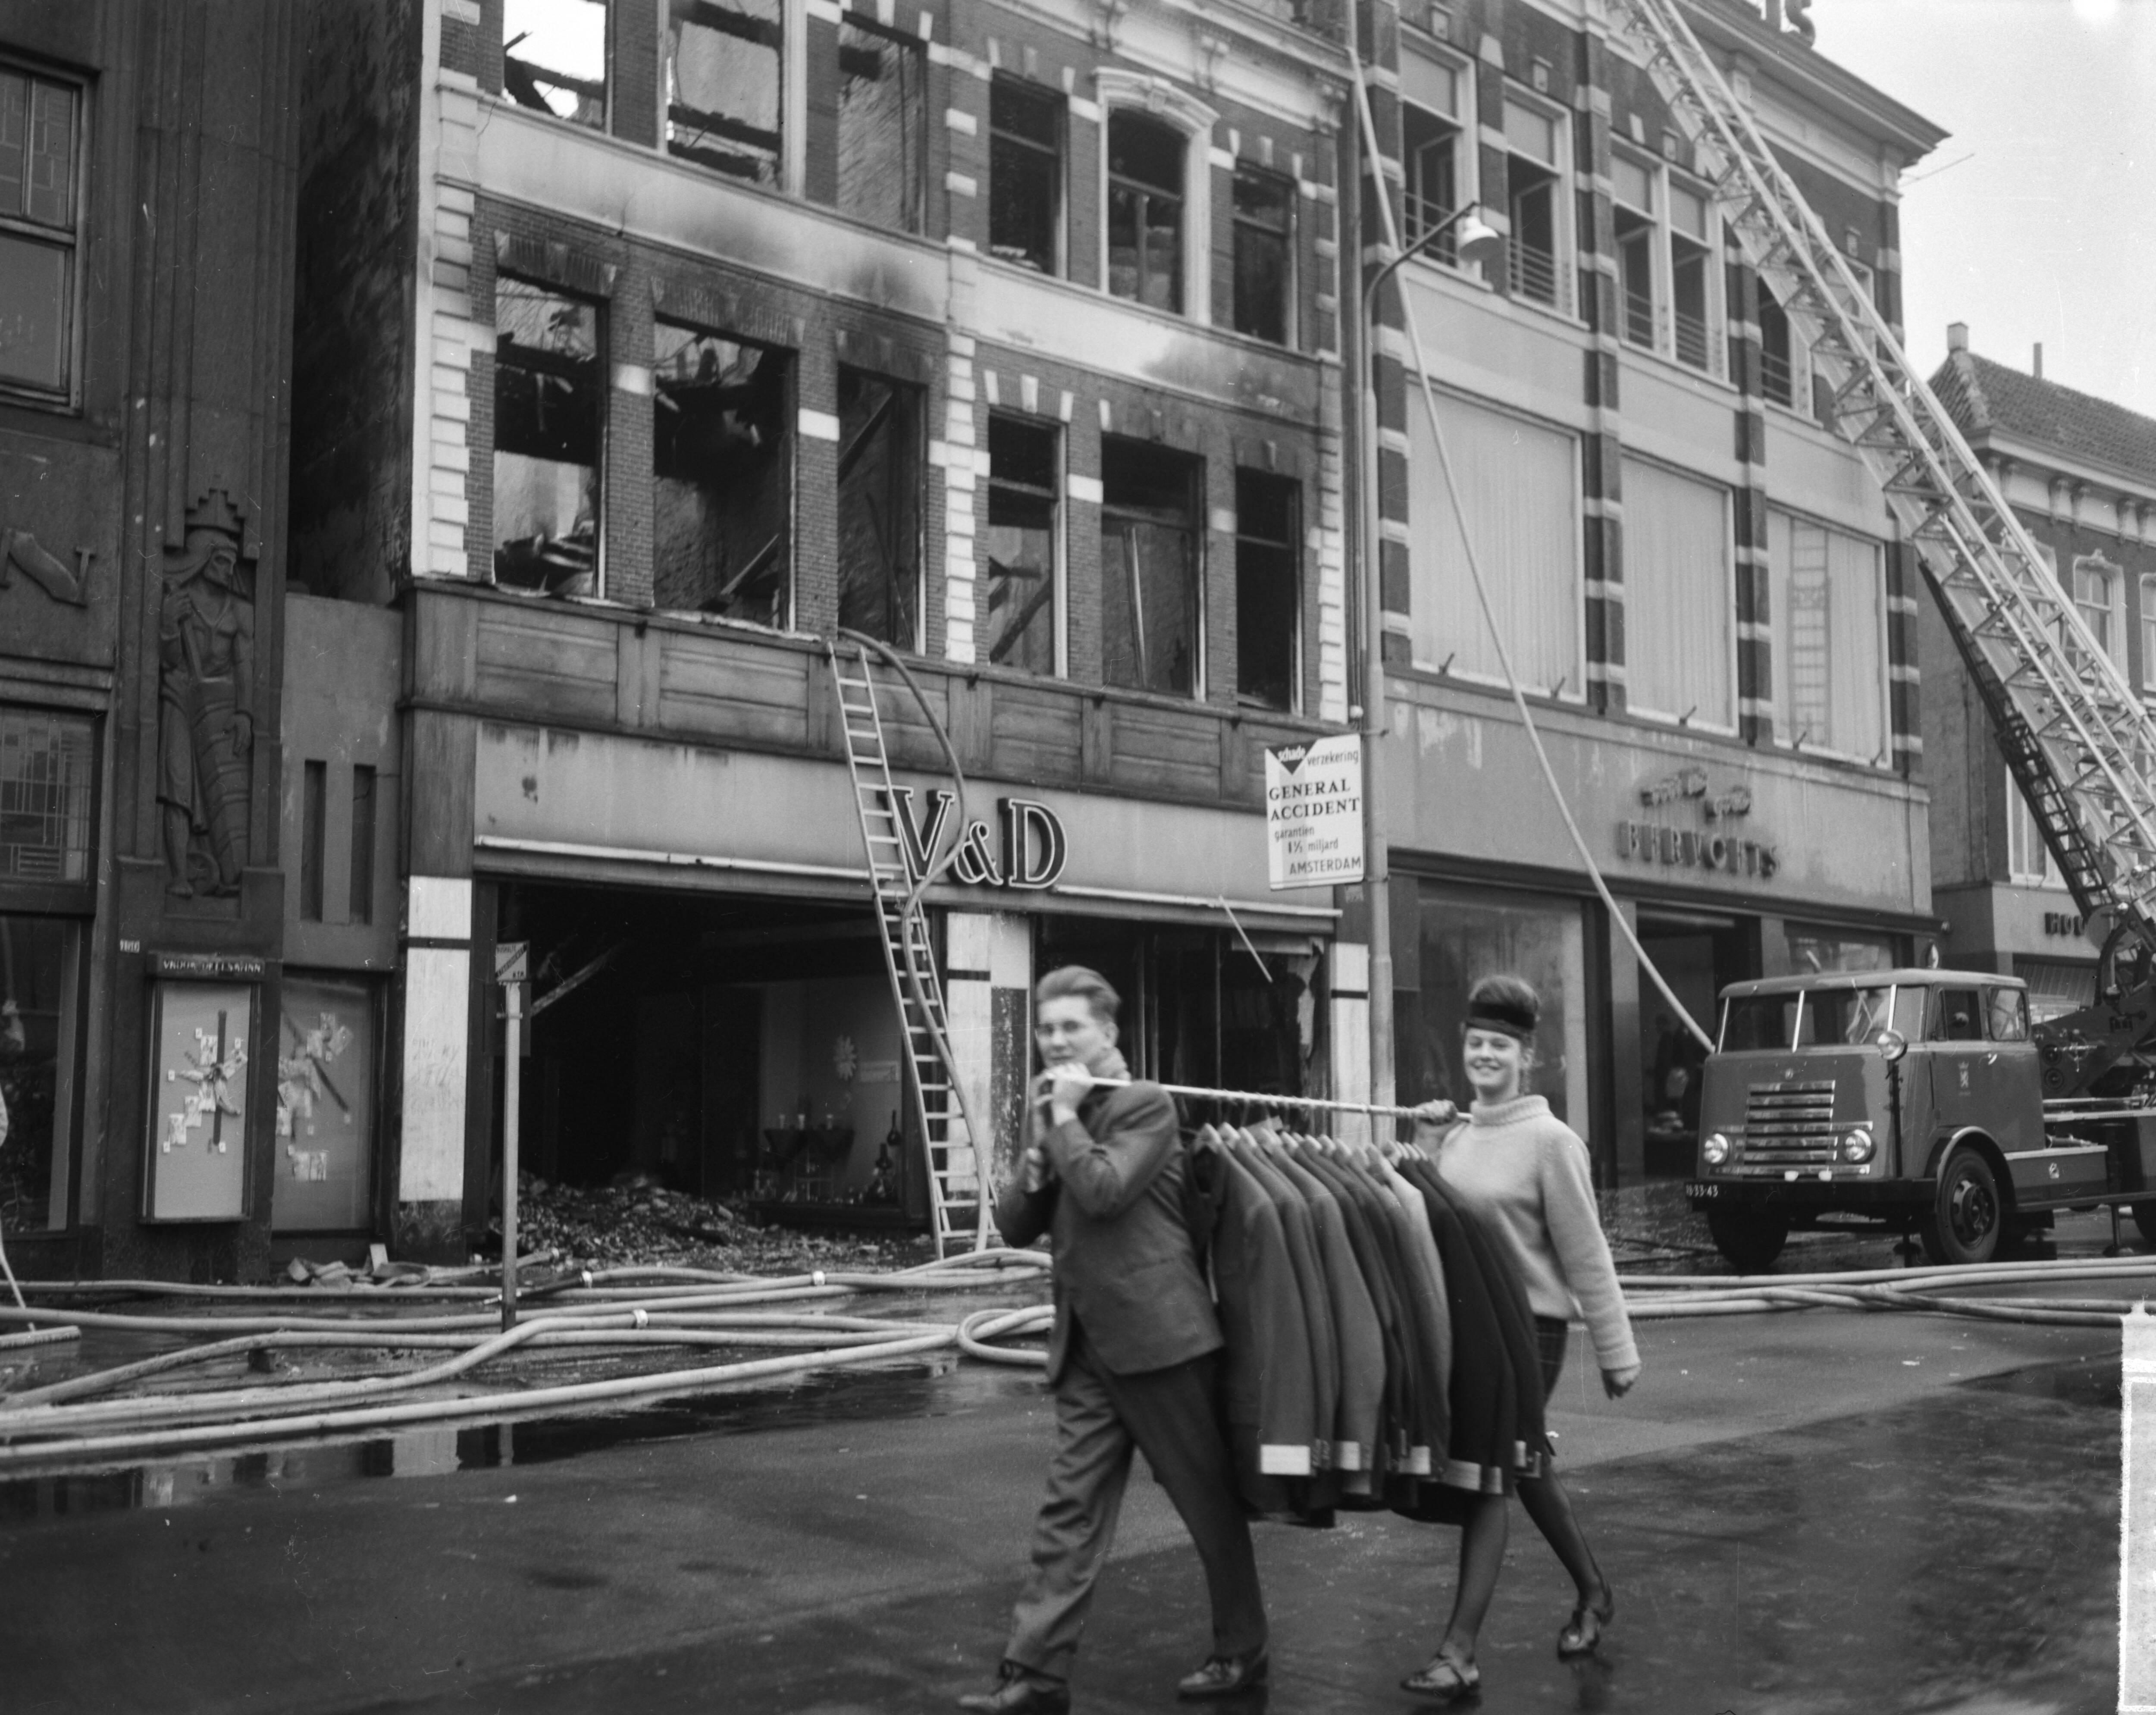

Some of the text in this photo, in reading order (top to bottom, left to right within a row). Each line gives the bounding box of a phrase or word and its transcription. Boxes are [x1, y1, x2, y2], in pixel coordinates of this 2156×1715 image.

[1307, 750, 1358, 766] verzekering
[1269, 779, 1351, 801] GENERAL
[1271, 798, 1360, 821] ACCIDENT
[877, 786, 1068, 889] V&D
[1308, 838, 1338, 854] miljard
[1290, 856, 1361, 875] AMSTERDAM
